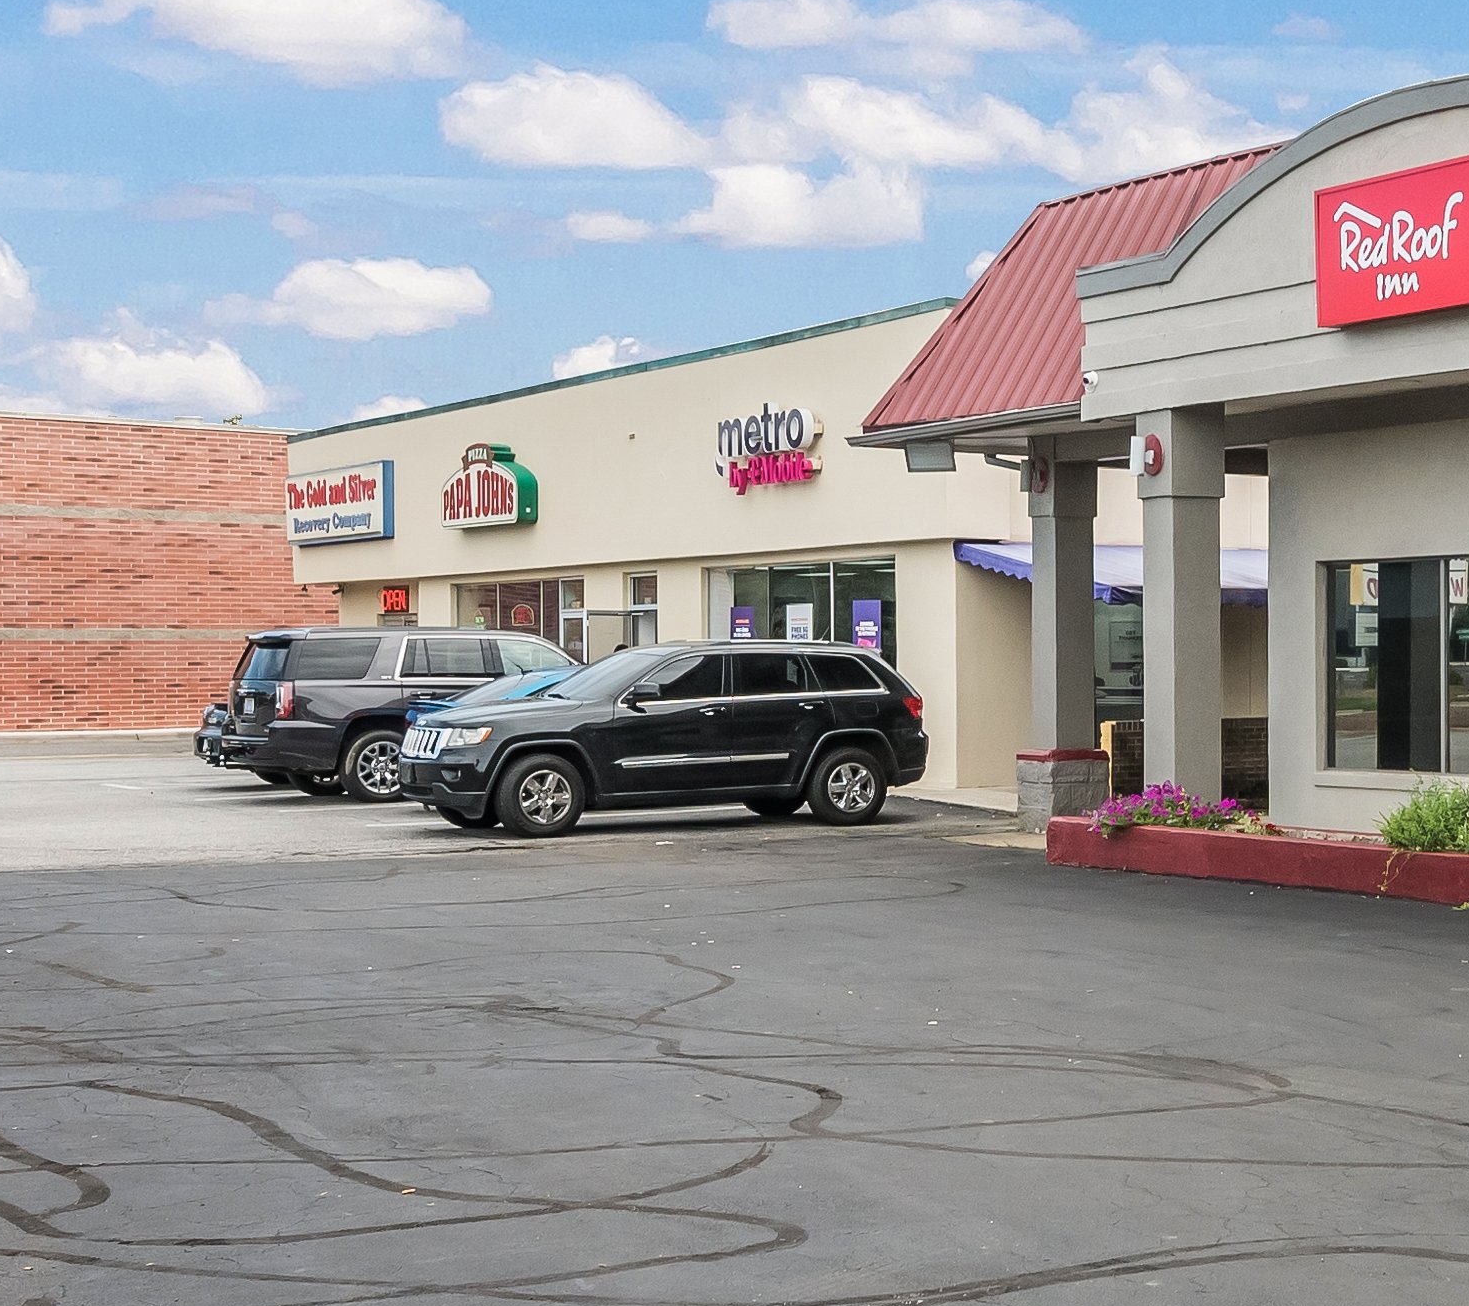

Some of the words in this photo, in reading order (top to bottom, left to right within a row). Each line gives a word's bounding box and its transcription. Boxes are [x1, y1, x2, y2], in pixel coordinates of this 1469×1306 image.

[1340, 220, 1391, 273] Red
[1392, 191, 1464, 264] Roof
[717, 402, 804, 457] metro
[467, 447, 488, 462] PIZZA
[287, 483, 305, 510] The
[306, 478, 328, 509] Gold
[329, 475, 347, 505] and
[348, 473, 377, 503] Silver
[443, 472, 473, 521] PAPA
[293, 517, 331, 534] Recovery
[332, 512, 372, 531] Company
[381, 589, 407, 611] OPEN
